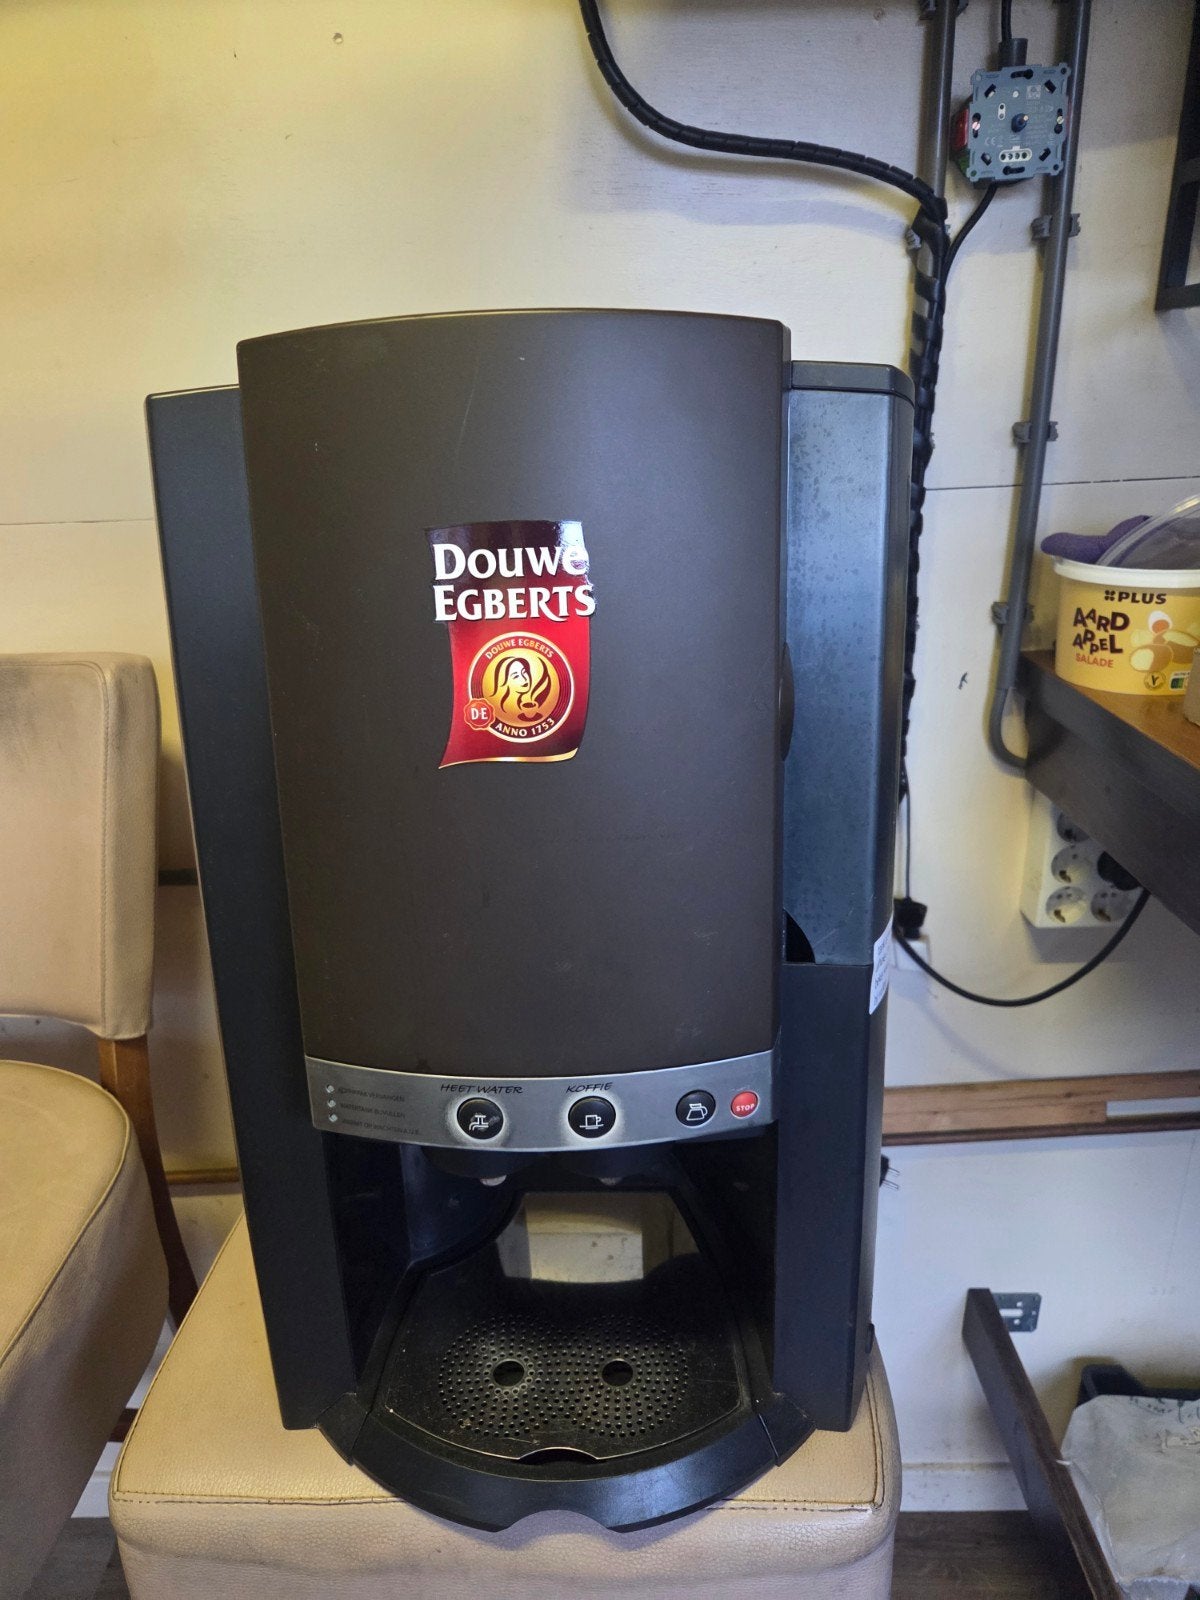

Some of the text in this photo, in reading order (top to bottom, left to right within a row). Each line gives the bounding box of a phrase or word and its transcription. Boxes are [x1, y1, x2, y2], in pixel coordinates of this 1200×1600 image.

[432, 583, 596, 622] EGBERTS
[1117, 591, 1167, 605] PLUS
[1073, 606, 1131, 633] AARD
[485, 639, 555, 660] DOUWE EGBERTS
[1072, 628, 1124, 655] APPEL
[1074, 653, 1115, 668] SALADE
[494, 717, 555, 737] ANNO 1753
[440, 1083, 524, 1094] HEET WATER
[565, 1081, 614, 1094] KOFFIE
[735, 1103, 755, 1112] STOP
